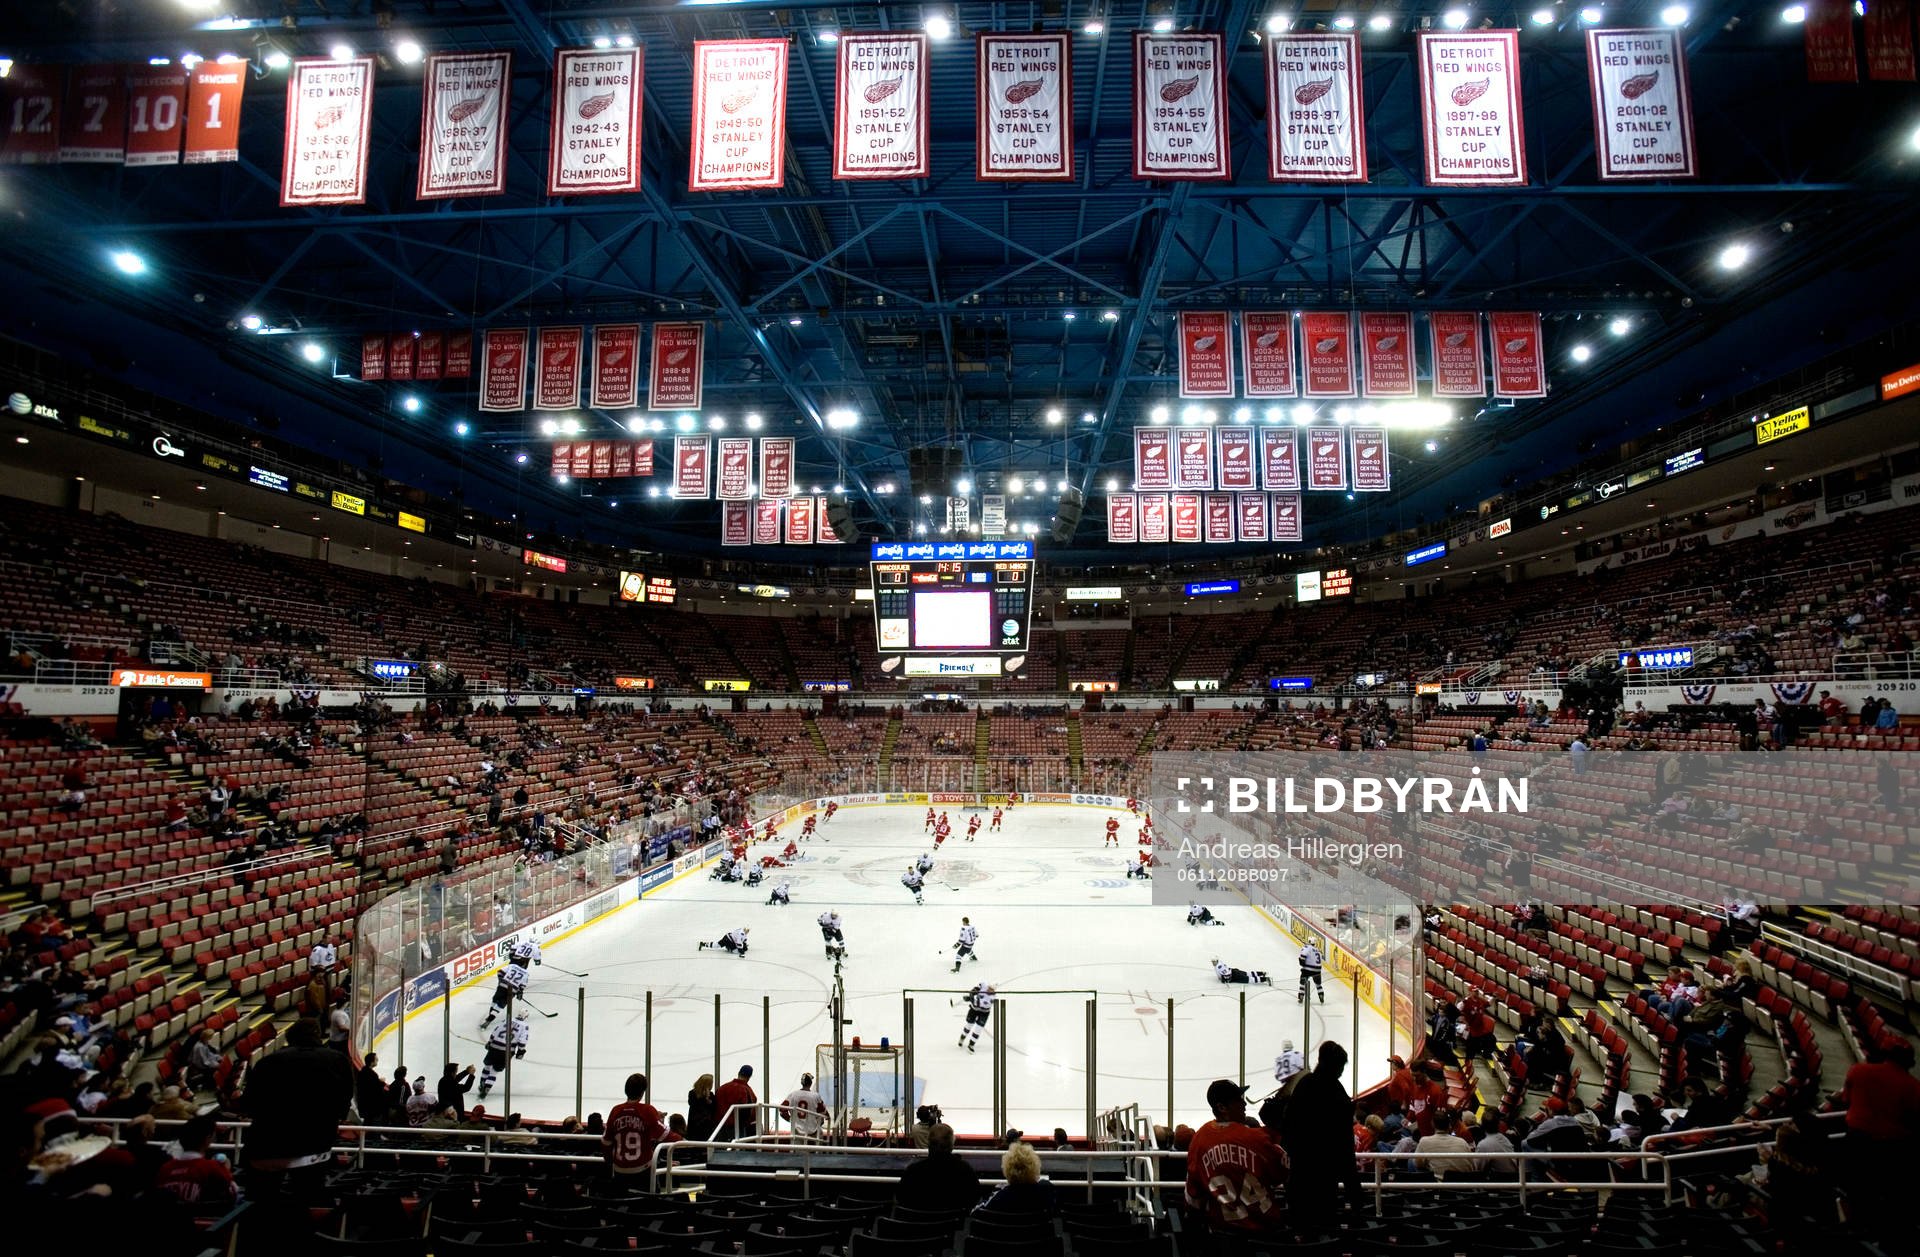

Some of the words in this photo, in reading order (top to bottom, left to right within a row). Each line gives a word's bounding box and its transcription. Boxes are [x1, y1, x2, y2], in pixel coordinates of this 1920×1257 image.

[1609, 40, 1663, 51] DETROIT
[858, 47, 909, 57] DETROIT
[998, 48, 1050, 58] DETROIT
[1153, 46, 1205, 56] DETROIT
[1285, 47, 1338, 57] DETROIT
[1441, 48, 1493, 58] DETROIT
[1148, 60, 1170, 70] RED
[1177, 60, 1210, 70] WINGS
[1604, 56, 1628, 66] RED
[1634, 54, 1671, 64] WINGS
[573, 61, 623, 72] DETROIT
[851, 61, 874, 71] RED
[880, 61, 914, 70] WINGS
[991, 62, 1015, 72] RED
[1021, 62, 1056, 72] WINGS
[1280, 62, 1303, 71] RED
[1310, 61, 1345, 71] WINGS
[1436, 63, 1458, 73] RED
[1465, 63, 1501, 72] WINGS
[445, 66, 493, 77] DETROIT
[738, 71, 772, 81] WINGS
[308, 72, 356, 84] DETROIT
[568, 77, 589, 87] RED
[596, 75, 628, 86] WINGS
[439, 81, 459, 91] RED
[466, 79, 498, 90] WINGS
[329, 86, 360, 96] WINGS
[134, 96, 178, 132] 10
[206, 92, 222, 128] 1
[860, 108, 905, 118] 1951-52
[1000, 109, 1048, 119] 1953-54
[1155, 108, 1205, 117] 1954-55
[1290, 110, 1339, 120] 1996-97
[1617, 105, 1667, 117] 2001-02
[1447, 111, 1497, 120] 1997-98
[572, 123, 619, 134] 1942-43
[856, 122, 909, 134] STANLEY
[997, 123, 1051, 133] STANLEY
[1154, 122, 1207, 132] STANLEY
[1288, 125, 1342, 135] STANLEY
[1446, 126, 1500, 137] STANLEY
[1616, 121, 1671, 132] STANLEY
[442, 127, 487, 138] 1936-37
[713, 133, 762, 143] STANLEY
[870, 138, 893, 148] CUP
[1169, 138, 1192, 148] CUP
[1633, 138, 1658, 148] CUP
[438, 141, 488, 153] STANLEY
[569, 137, 620, 150] STANLEY
[1013, 139, 1036, 148] CUP
[1304, 140, 1328, 150] CUP
[1462, 142, 1486, 152] CUP
[726, 148, 748, 157] CUP
[1148, 152, 1215, 163] CHAMPIONS
[451, 157, 472, 166] CUP
[584, 154, 606, 164] CUP
[849, 152, 915, 164] CHAMPIONS
[991, 154, 1058, 164] CHAMPIONS
[1284, 156, 1351, 166] CHAMPIONS
[1441, 158, 1510, 168] CHAMPIONS
[1613, 154, 1682, 164] CHAMPIONS
[705, 162, 768, 174] CHAMPIONS
[431, 170, 492, 184] CHAMPIONS
[562, 167, 626, 180] CHAMPIONS
[295, 179, 354, 190] CHAMPIONS
[1883, 380, 1899, 392] The
[34, 404, 59, 419] at&t
[1772, 410, 1806, 428] Yellow
[1773, 423, 1798, 438] Book
[342, 503, 358, 512] Book
[937, 563, 961, 572] 14:15
[894, 573, 900, 582] 0
[1012, 572, 1018, 581] 0
[1002, 637, 1020, 645] at&t
[138, 673, 165, 685] Little
[543, 920, 561, 934] GMC
[518, 945, 532, 957] 38
[454, 945, 495, 979] DSR
[1341, 952, 1354, 980] Big
[507, 970, 523, 984] 32
[615, 1132, 641, 1161] 19
[1202, 1144, 1256, 1178] PROBERT
[1208, 1174, 1272, 1220] 24
